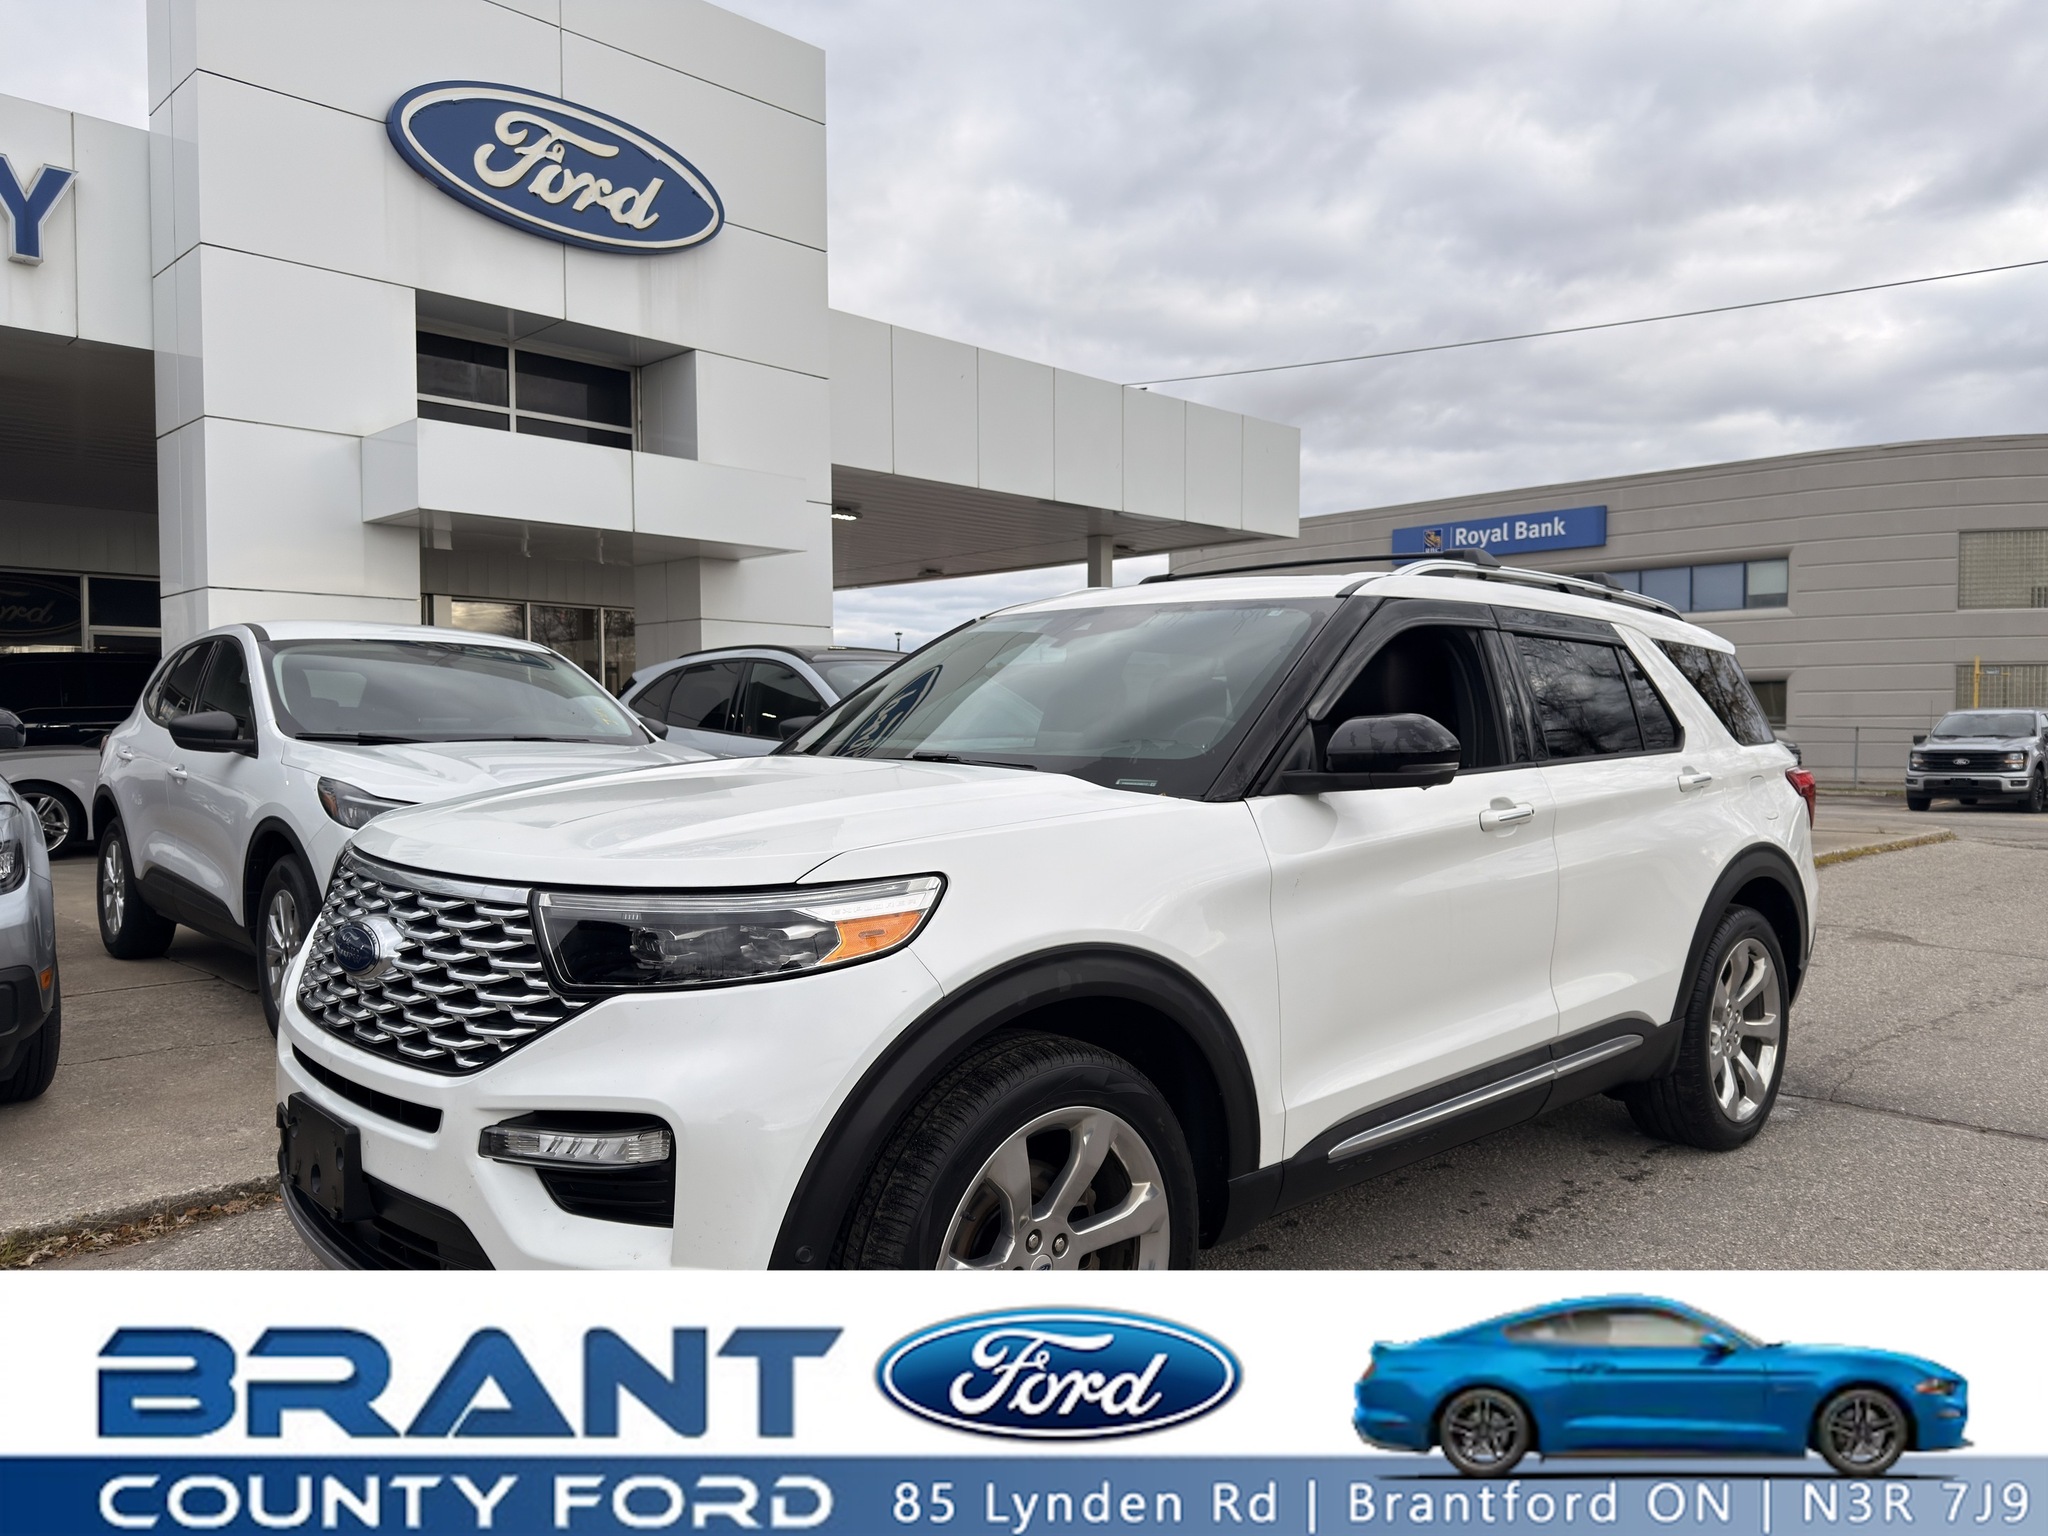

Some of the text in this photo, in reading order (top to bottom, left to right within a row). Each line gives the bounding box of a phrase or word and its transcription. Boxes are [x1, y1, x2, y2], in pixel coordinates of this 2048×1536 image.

[473, 110, 665, 230] Ford
[1455, 516, 1566, 548] Royal Bank
